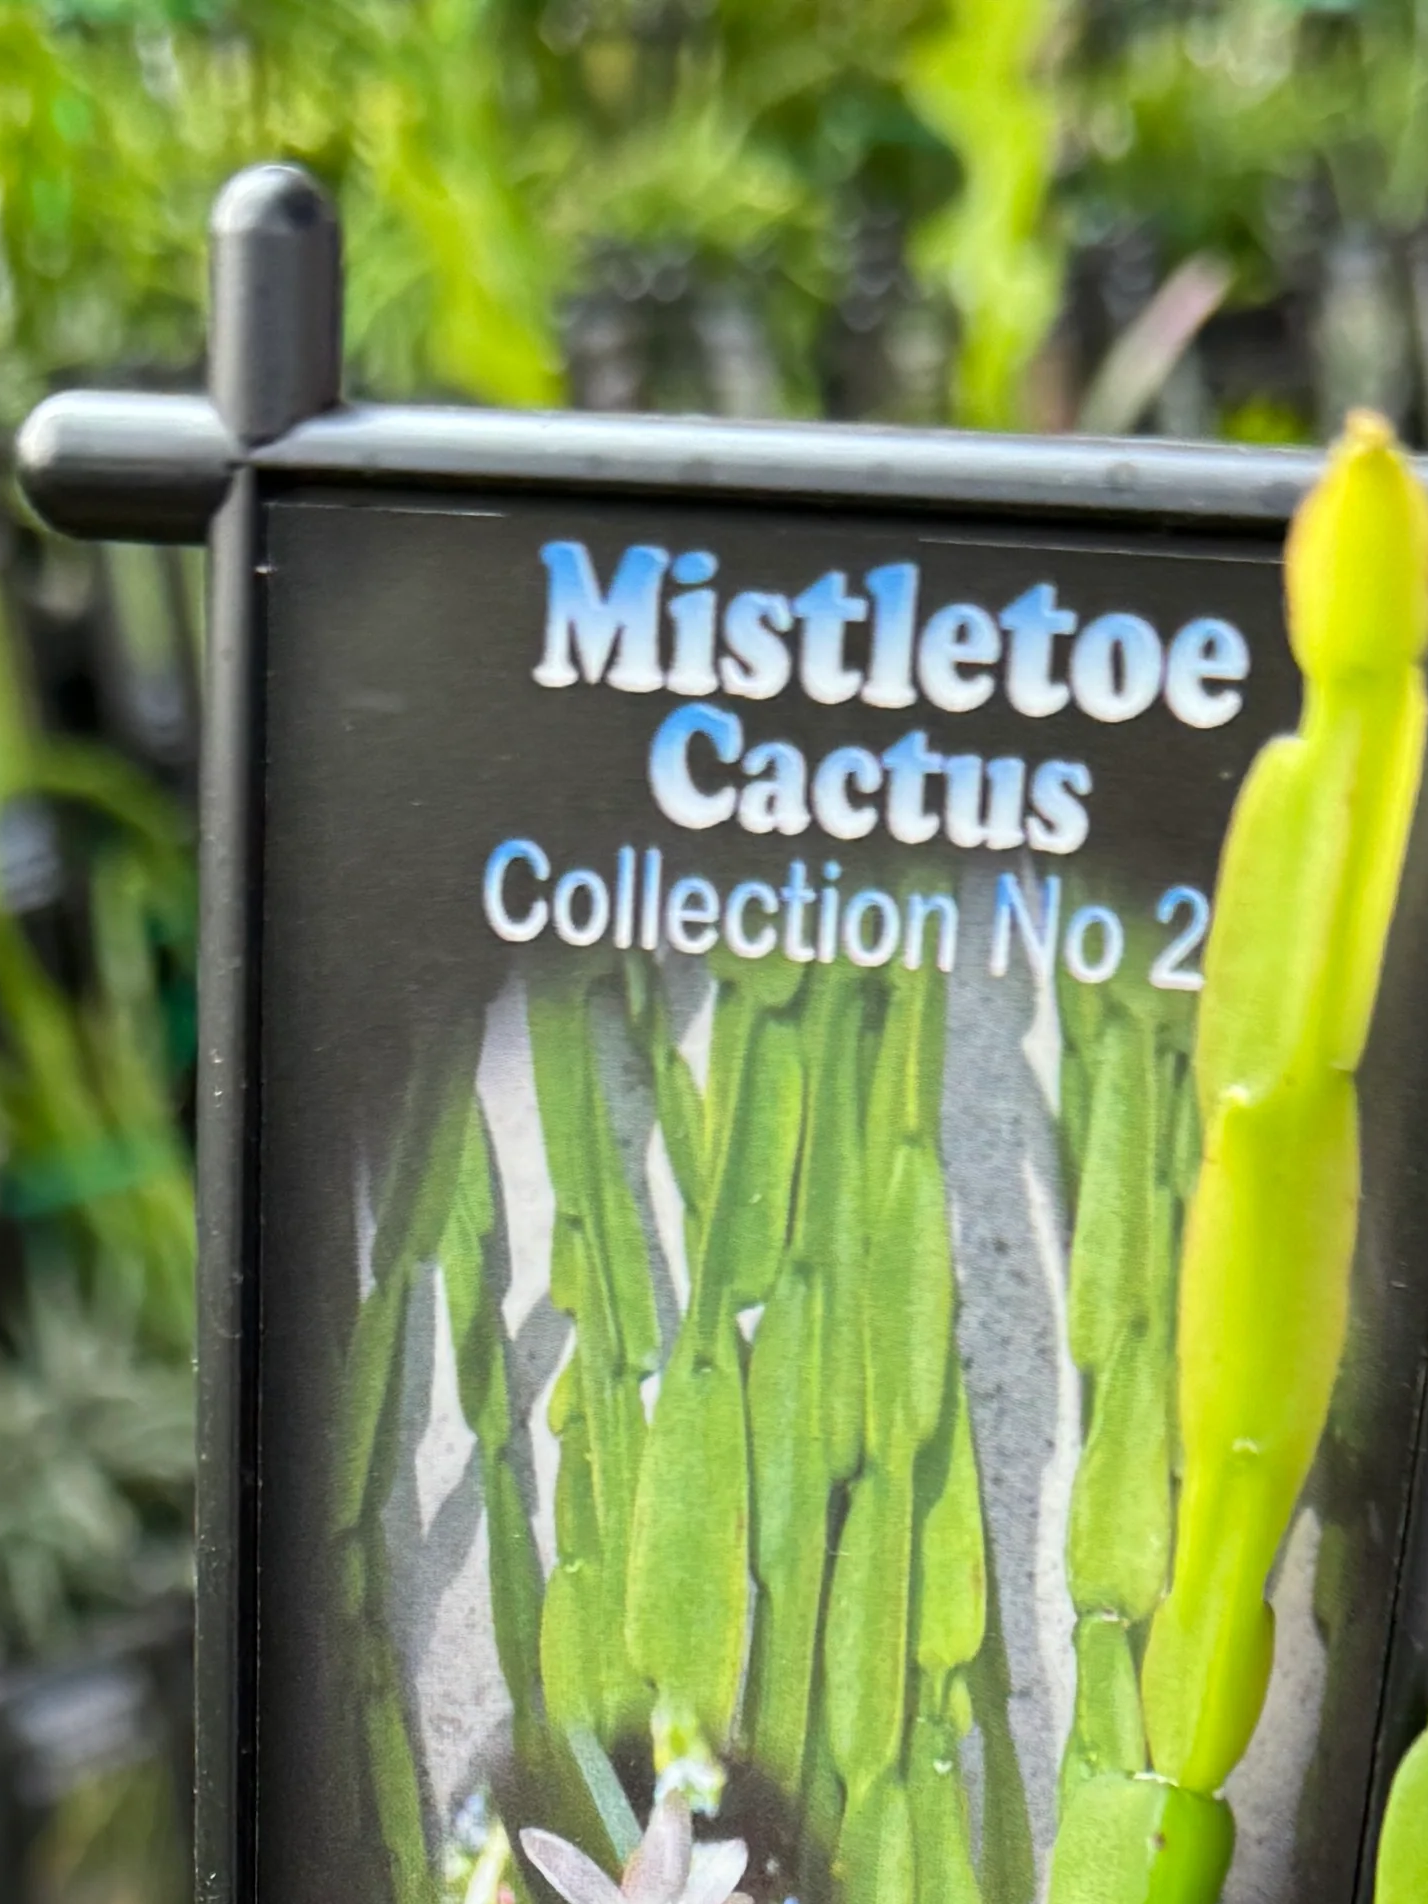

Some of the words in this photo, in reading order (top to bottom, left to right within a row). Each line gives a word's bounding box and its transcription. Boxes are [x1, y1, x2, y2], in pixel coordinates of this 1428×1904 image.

[532, 540, 1252, 729] Mistletoe
[648, 701, 1093, 854] Cactus
[483, 838, 960, 973] Collection
[988, 871, 1125, 985] No
